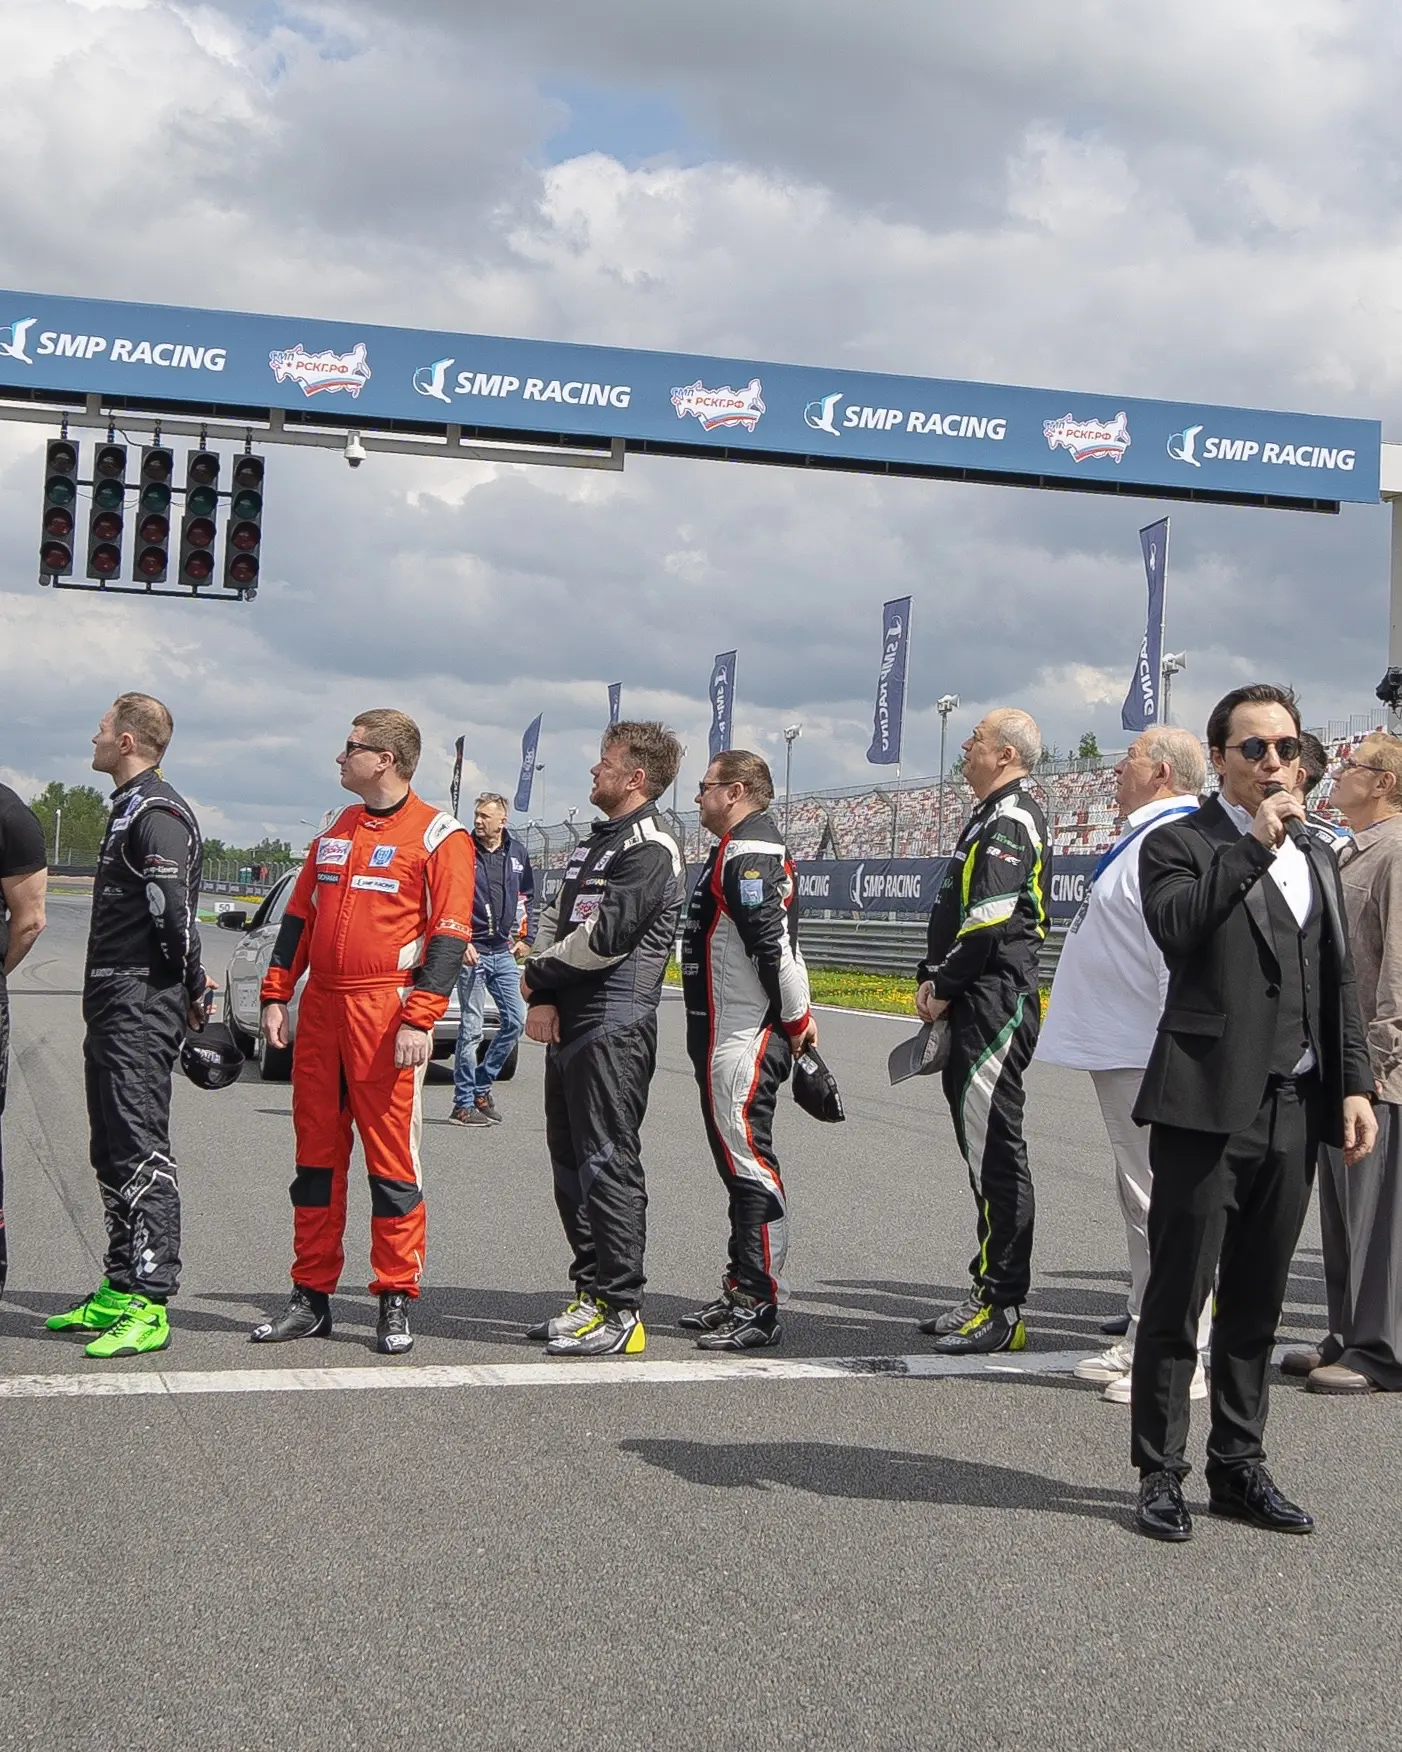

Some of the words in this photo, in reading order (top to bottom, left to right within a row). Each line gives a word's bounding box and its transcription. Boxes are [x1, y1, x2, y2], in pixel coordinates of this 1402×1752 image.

[36, 331, 107, 359] SMP
[109, 339, 227, 371] RACING
[295, 361, 349, 374] РСКГ.РФ
[454, 371, 520, 397] SMP
[522, 378, 631, 408] RACING
[695, 397, 744, 409] РСКГ.РФ
[843, 406, 903, 430] SMP
[905, 411, 1007, 440] RACING
[1066, 429, 1112, 441] РСКГ.РФ
[1202, 437, 1259, 461] SMP
[1261, 443, 1356, 471] RACING
[798, 875, 830, 897] RACING
[863, 875, 884, 898] SMP
[885, 875, 921, 898] RACING
[1051, 874, 1085, 902] CING
[218, 903, 231, 912] 50
